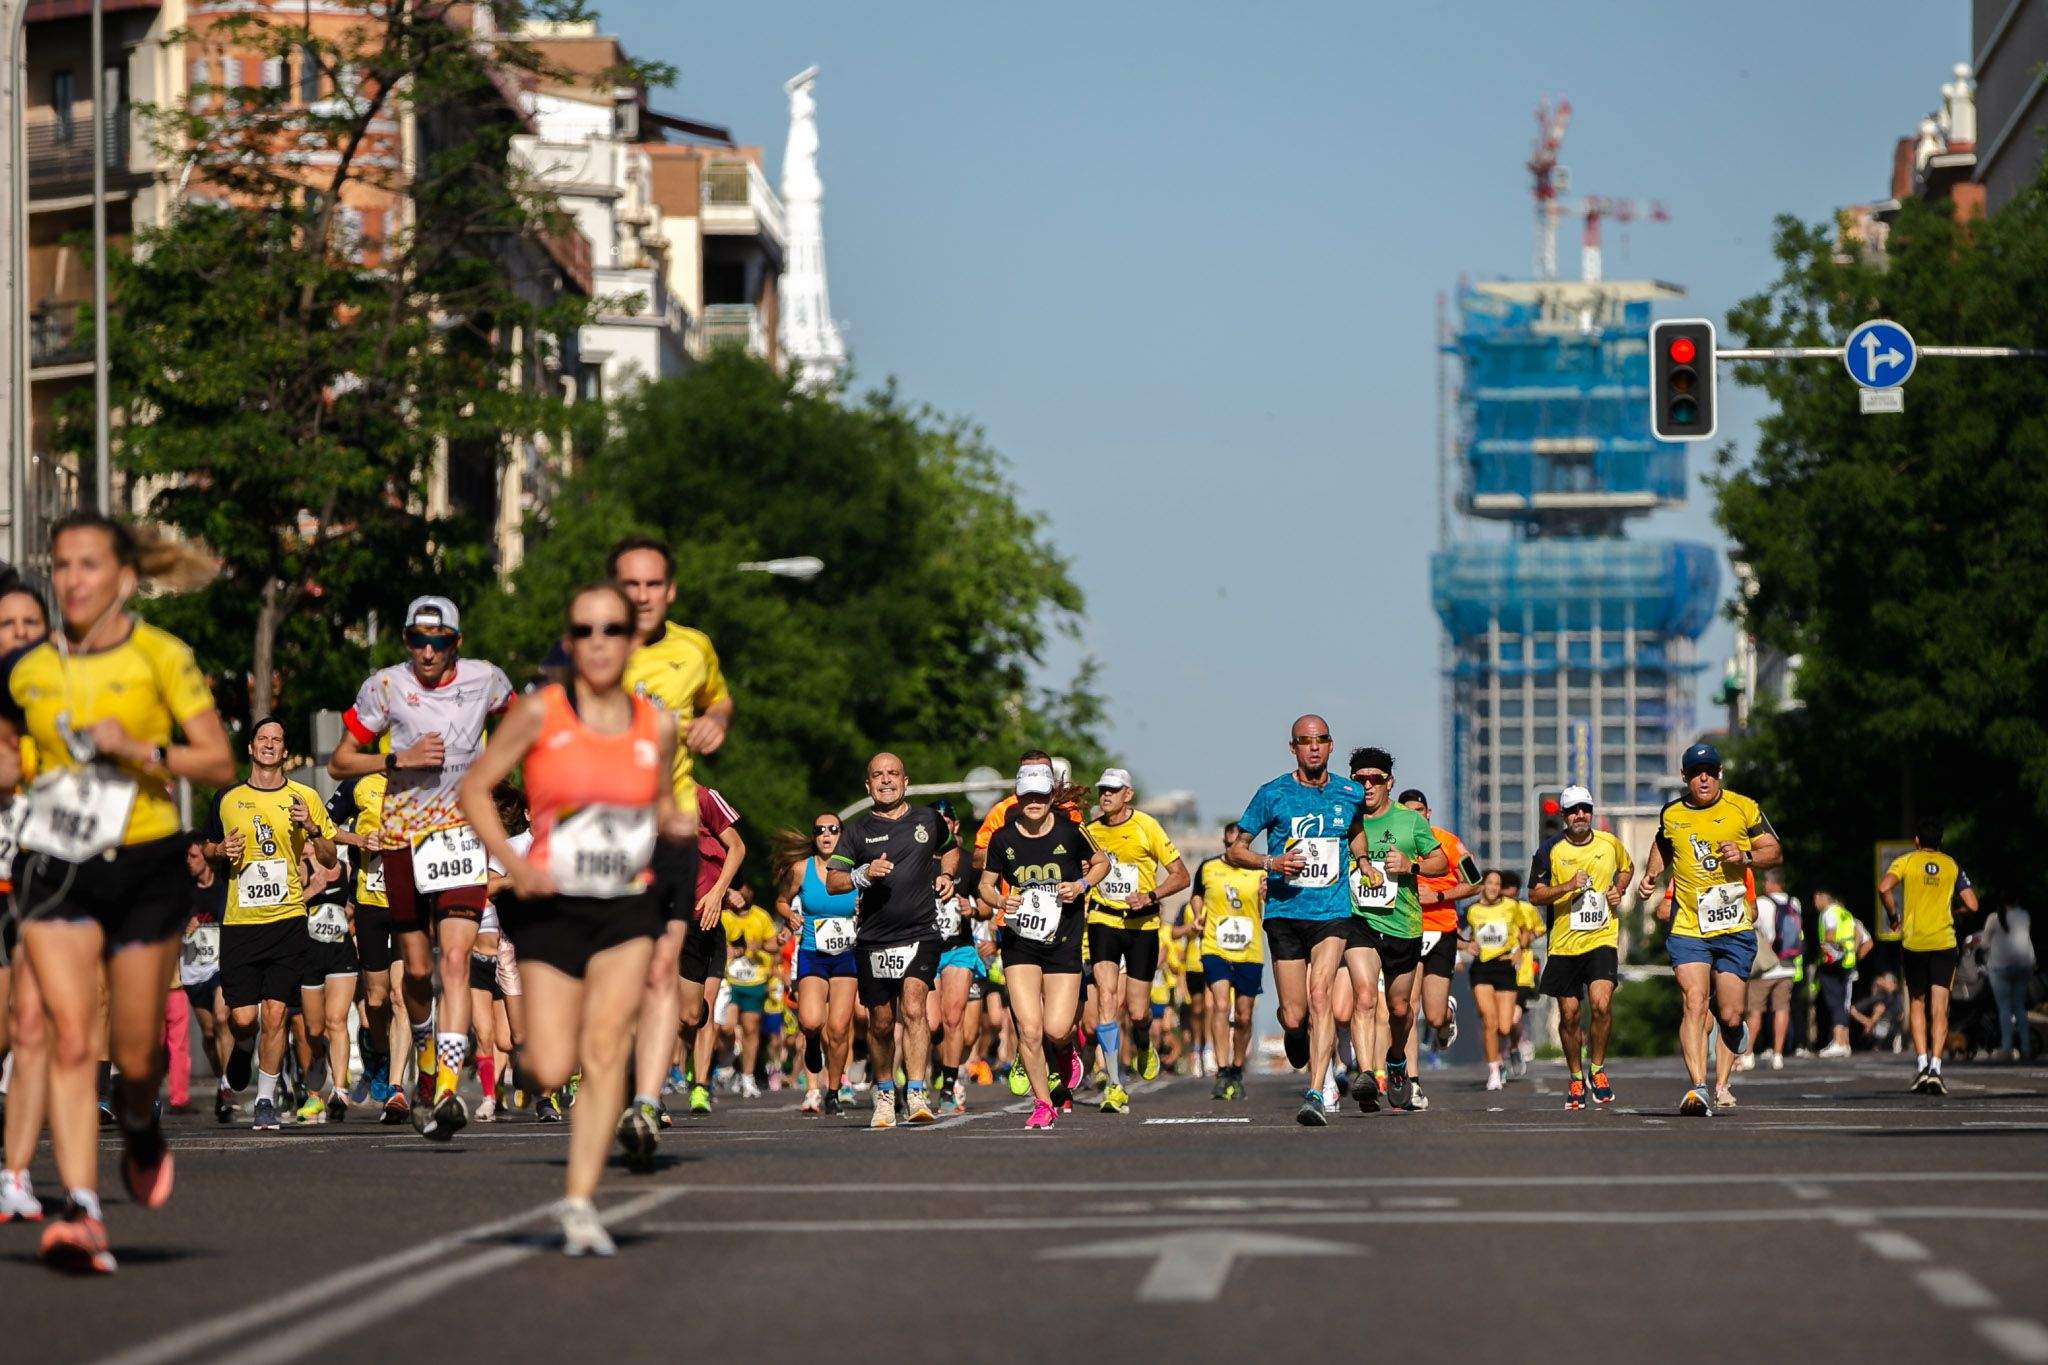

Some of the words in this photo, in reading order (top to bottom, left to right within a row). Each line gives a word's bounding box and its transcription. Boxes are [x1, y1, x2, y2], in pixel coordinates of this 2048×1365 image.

[264, 844, 275, 853] 13
[427, 857, 473, 880] 3498
[1300, 863, 1328, 878] 504
[1704, 859, 1716, 869] 13
[1013, 862, 1062, 884] 100
[247, 882, 281, 899] 3280
[1105, 882, 1131, 894] 3529
[1016, 912, 1047, 931] 1501
[1707, 904, 1738, 923] 3553
[825, 936, 850, 950] 1584
